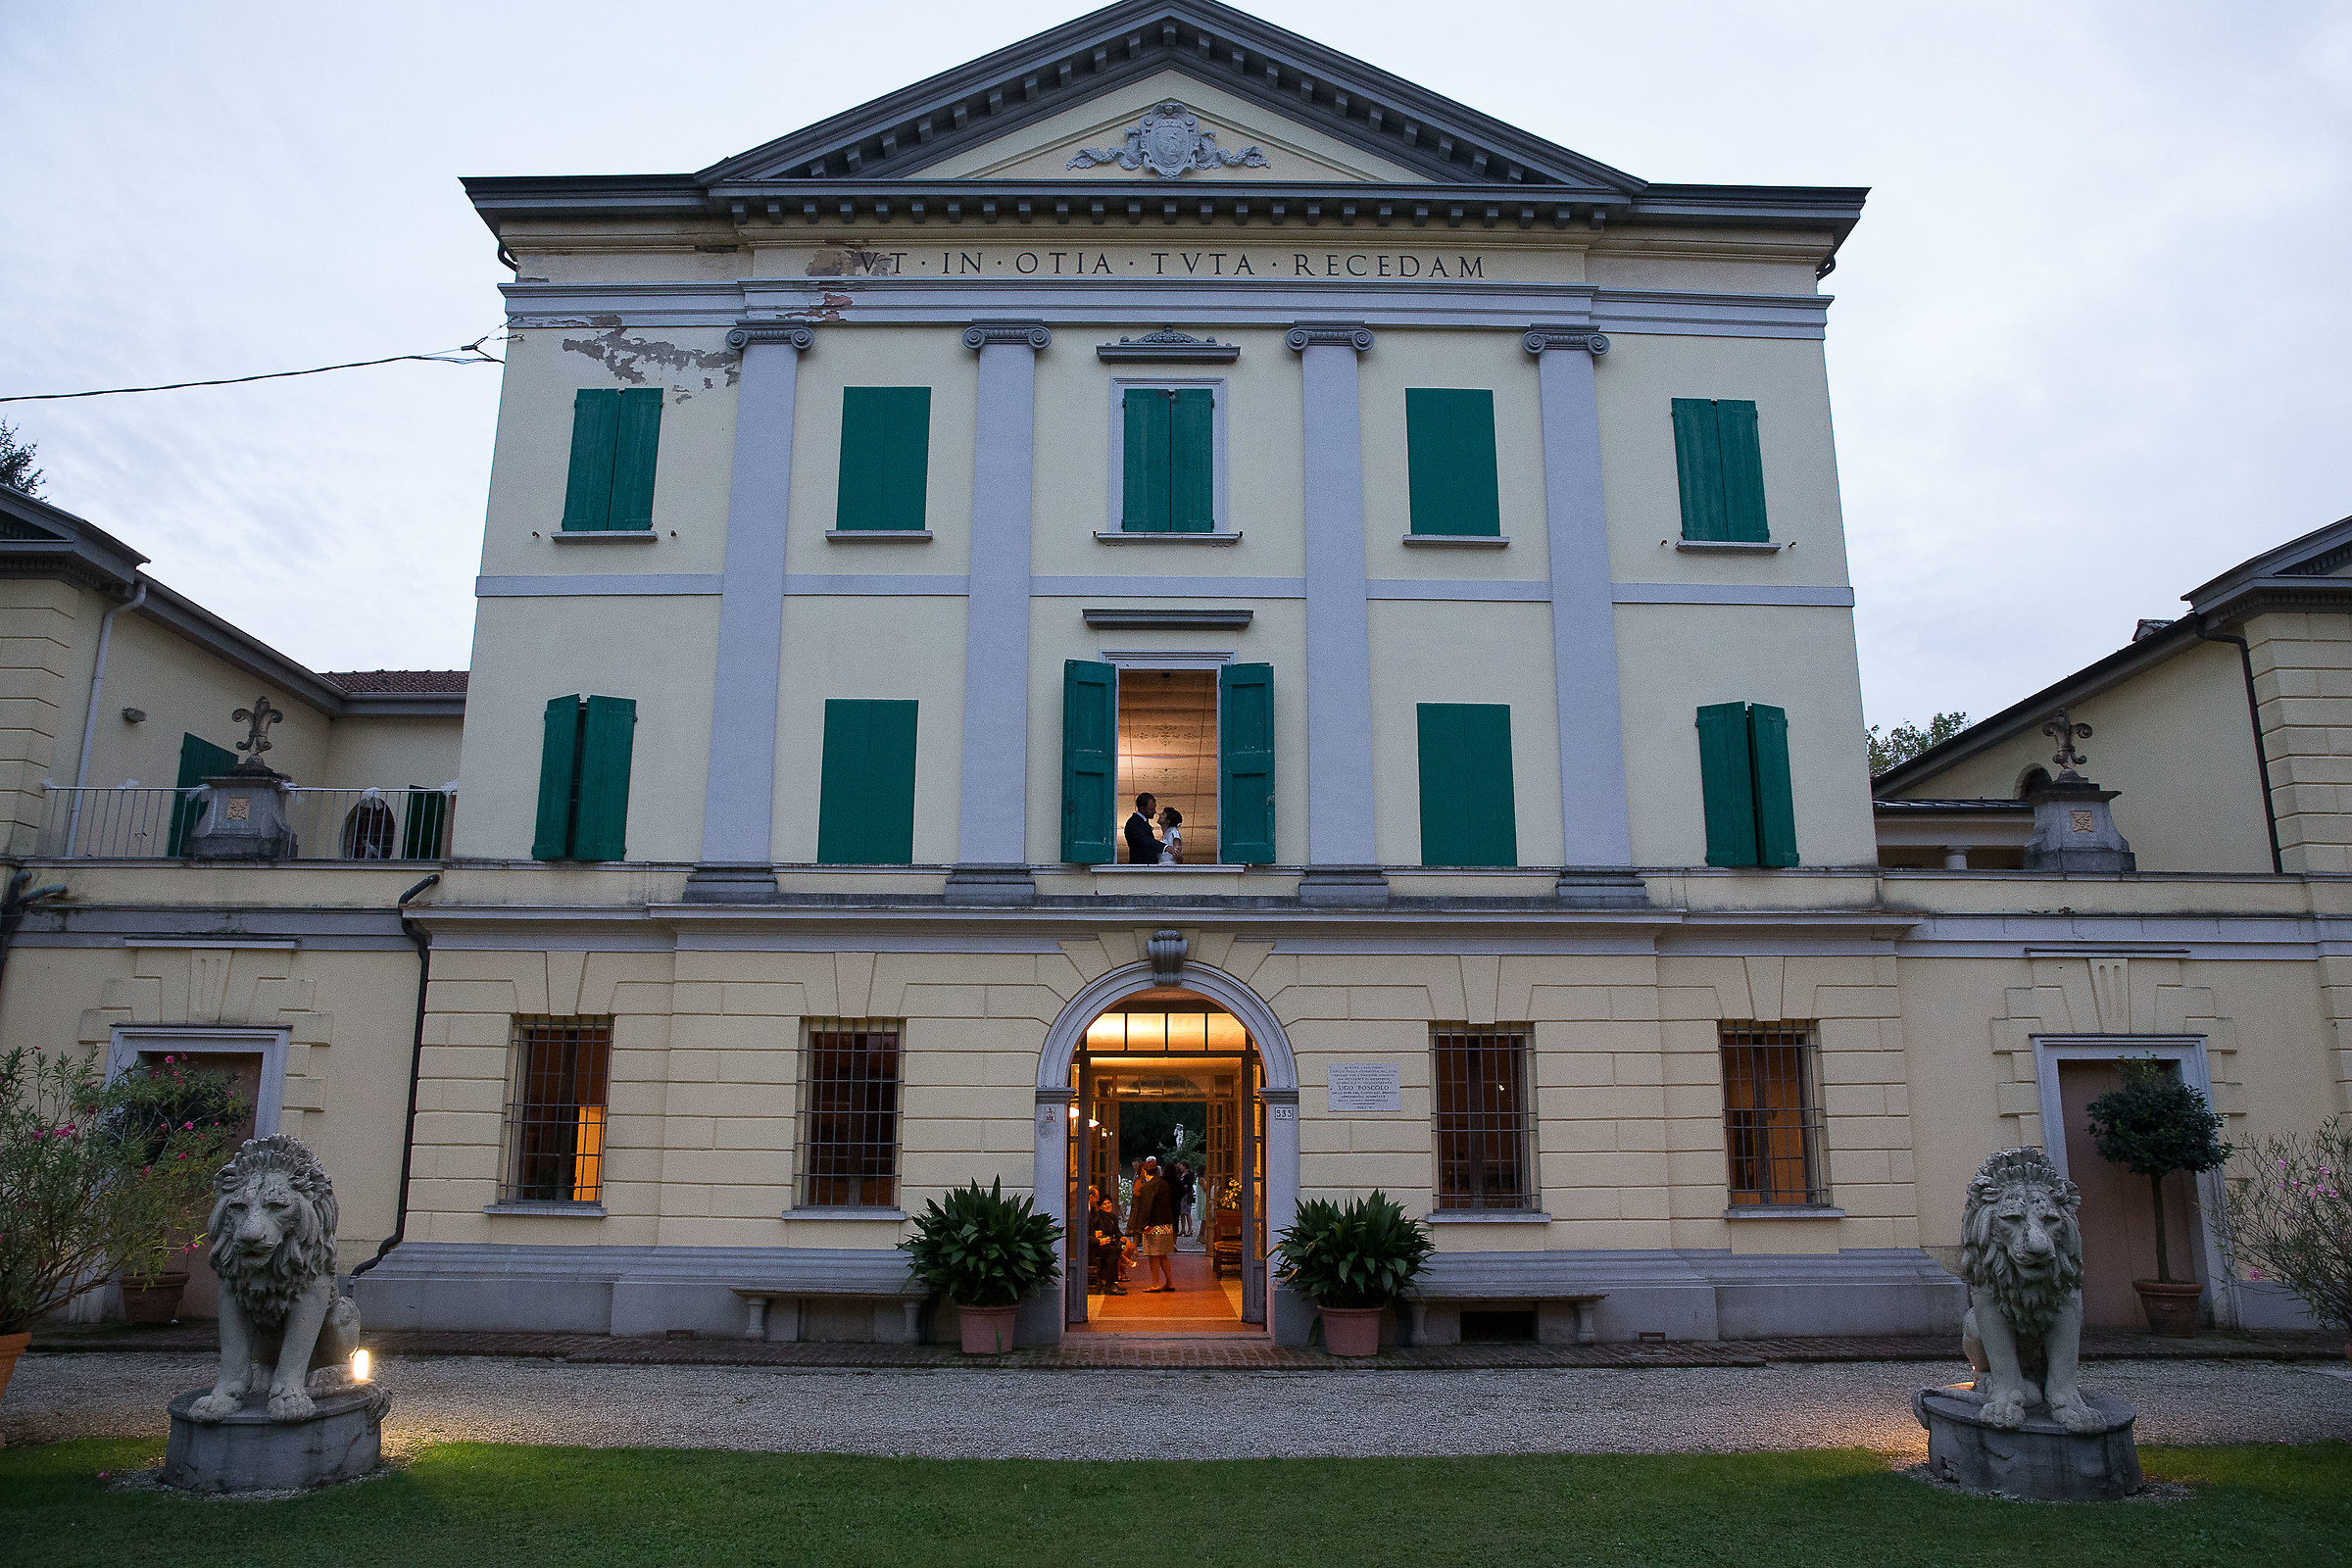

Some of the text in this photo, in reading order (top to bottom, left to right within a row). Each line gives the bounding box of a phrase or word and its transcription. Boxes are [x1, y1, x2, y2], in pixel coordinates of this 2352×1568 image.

[859, 252, 1485, 278] VT IN OTIA TVTA RECEDAM
